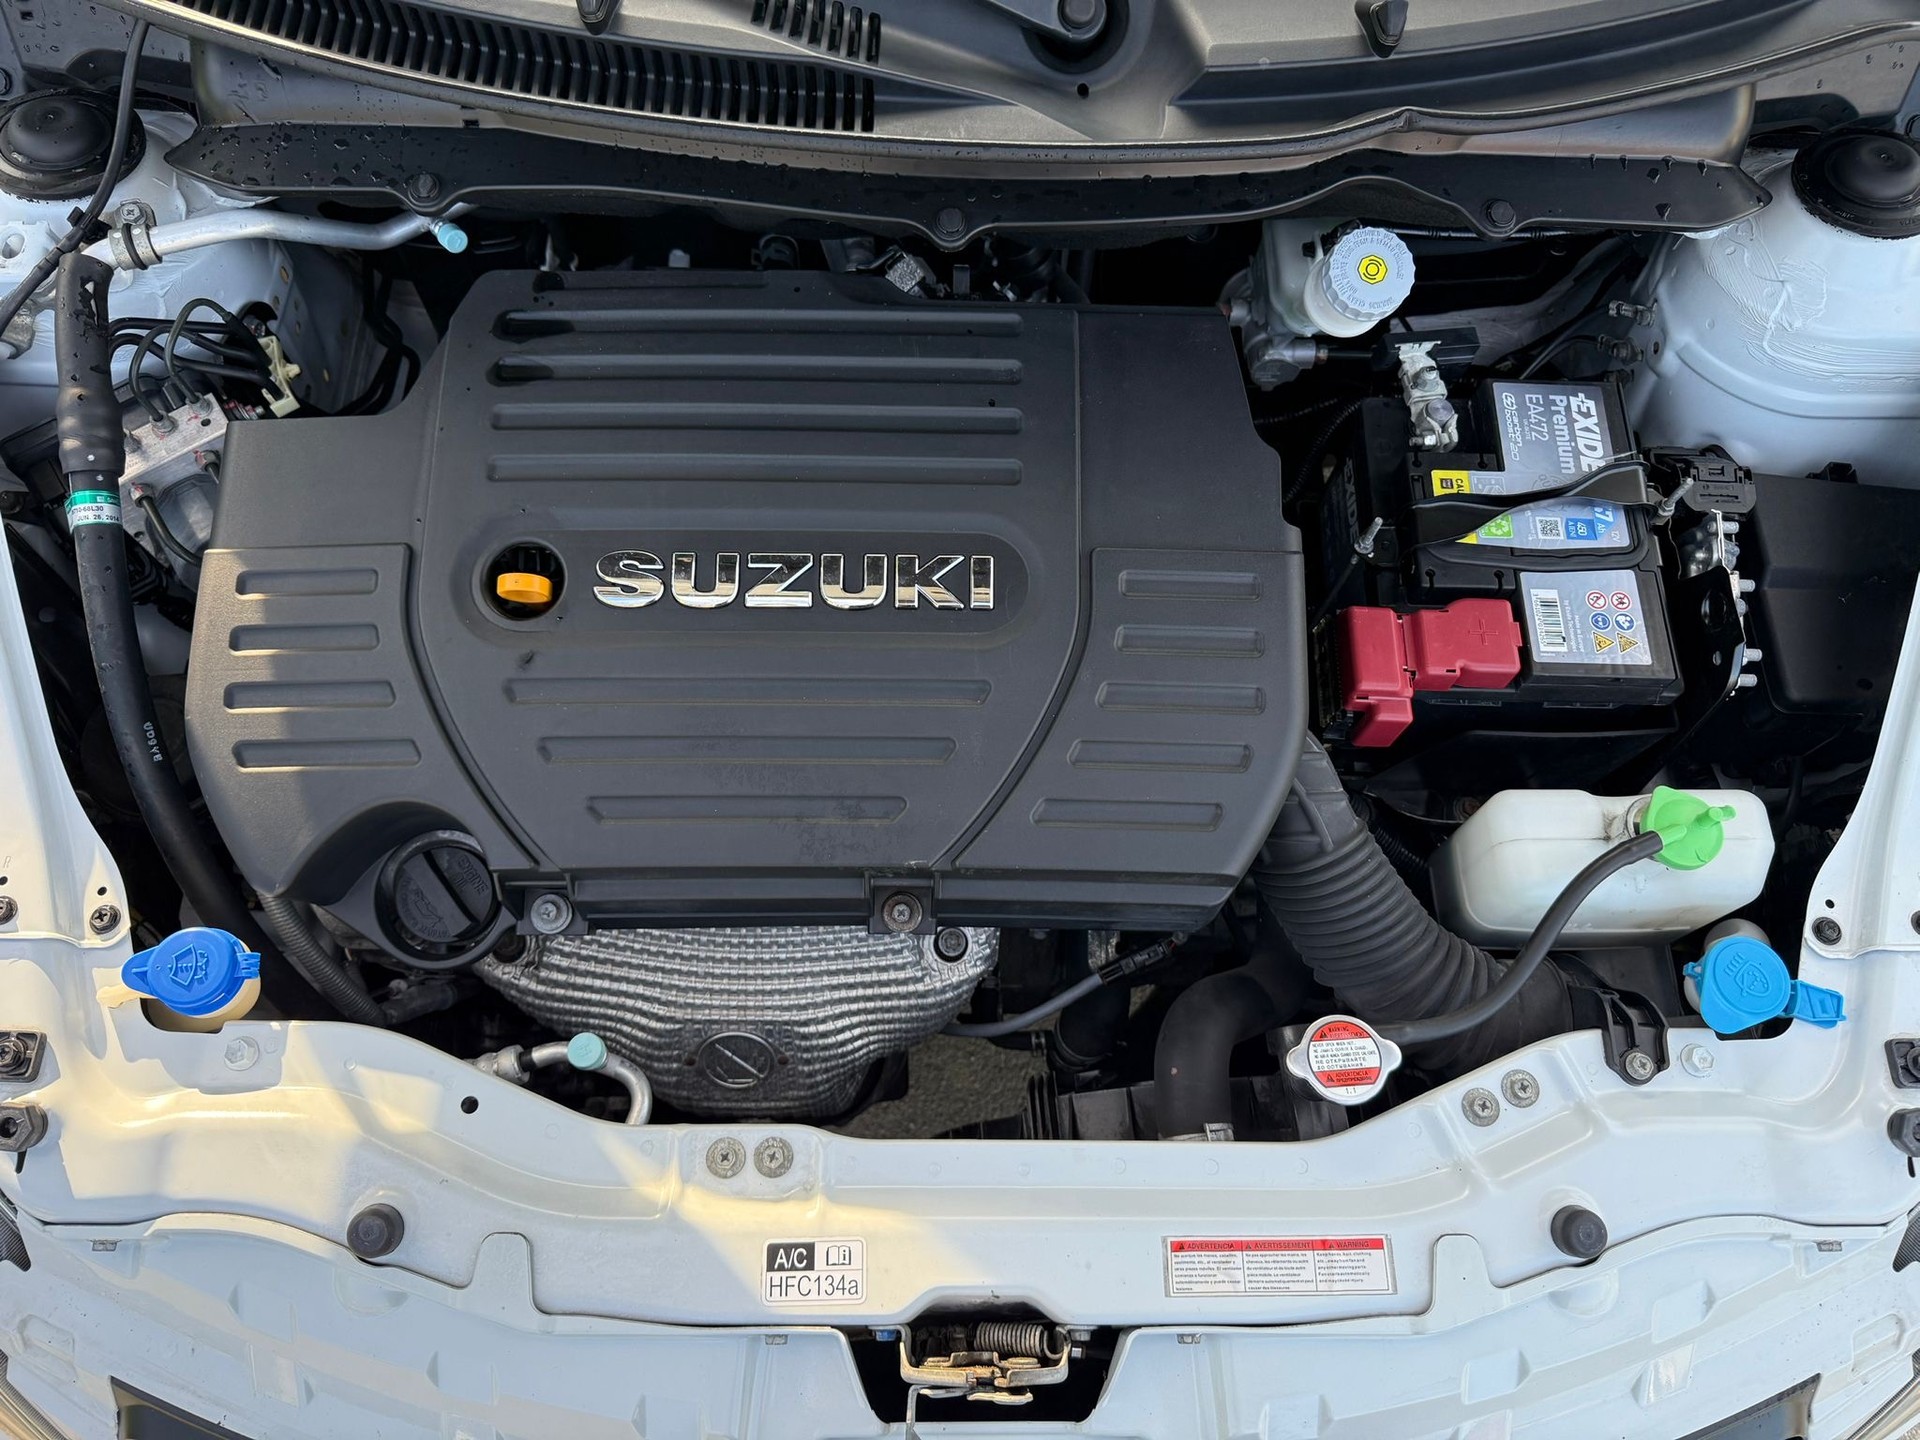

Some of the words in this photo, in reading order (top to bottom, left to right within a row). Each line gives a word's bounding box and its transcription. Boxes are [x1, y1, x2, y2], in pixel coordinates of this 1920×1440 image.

[1525, 394, 1549, 441] EA472
[1569, 393, 1606, 472] EXIDE
[1549, 395, 1576, 474] Premium
[1577, 522, 1588, 536] 450
[1597, 523, 1606, 534] Ah
[593, 550, 995, 609] SUZUKI
[457, 854, 489, 896] ENGINE
[774, 1248, 808, 1269] A/C
[1255, 1242, 1311, 1250] AVERTISSEMENT
[770, 1275, 859, 1298] HFC134a
